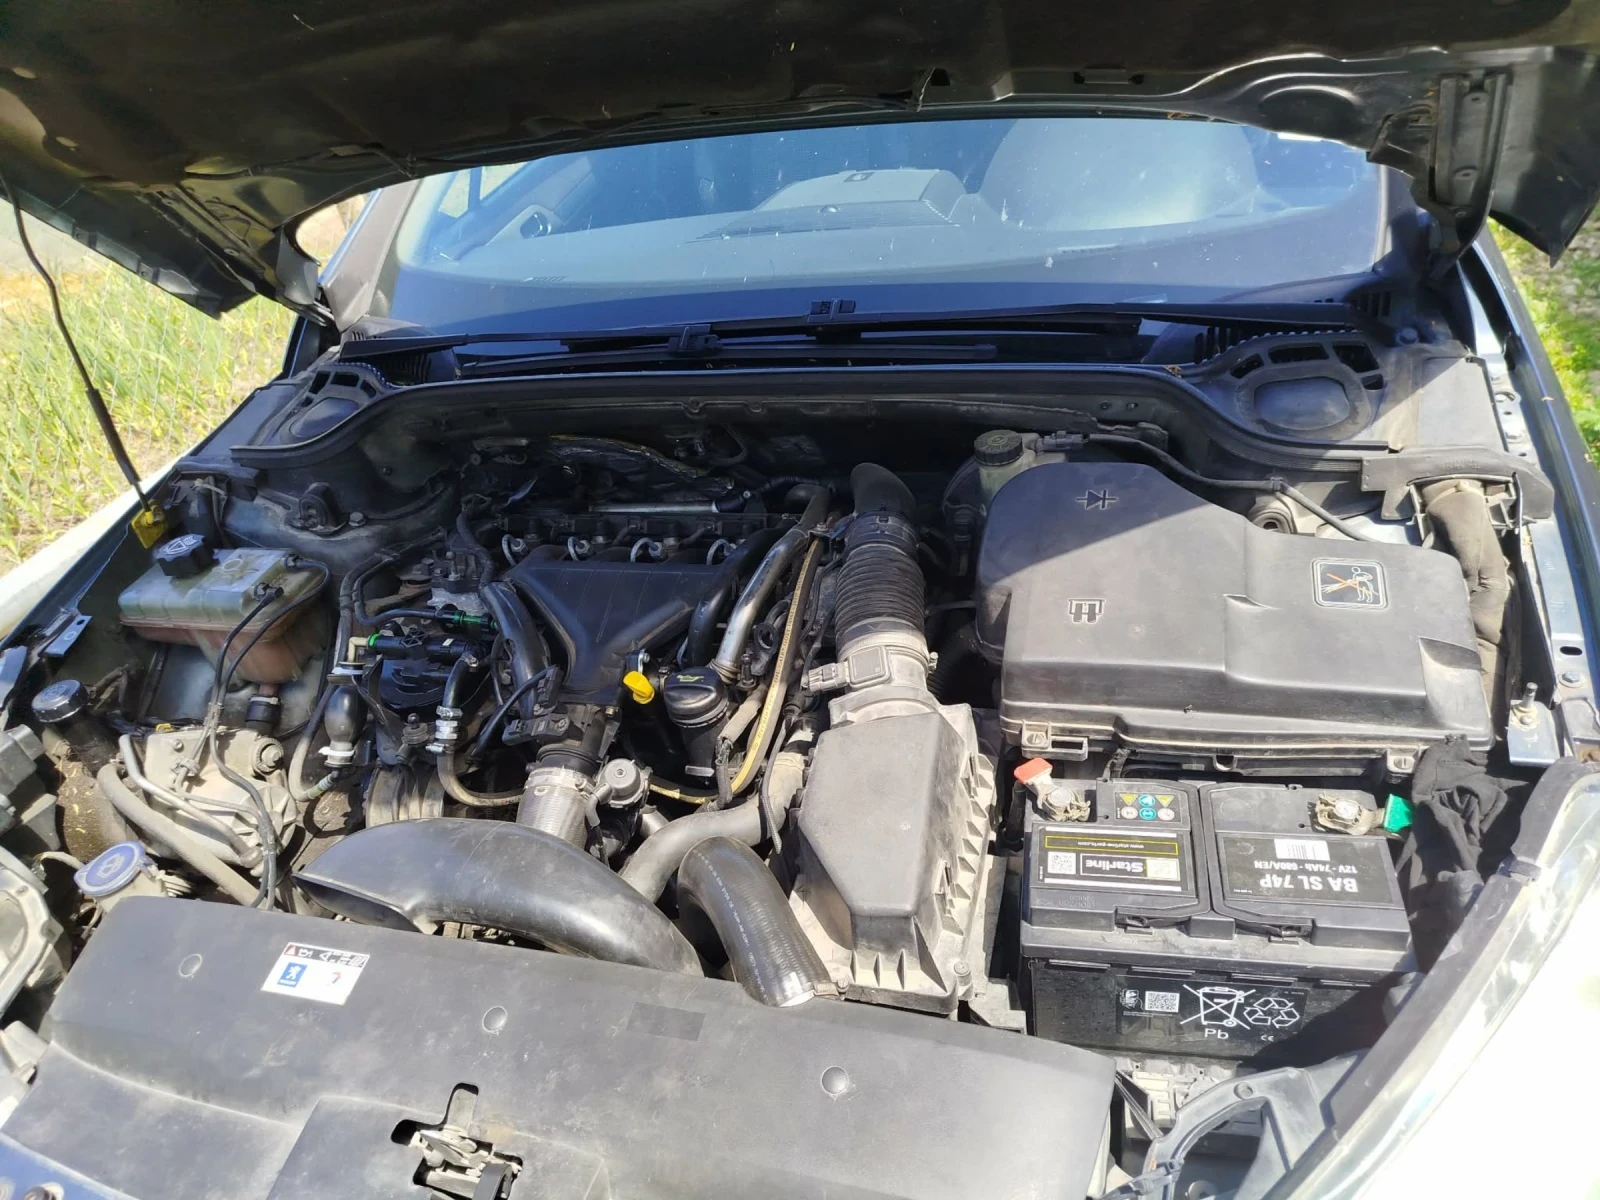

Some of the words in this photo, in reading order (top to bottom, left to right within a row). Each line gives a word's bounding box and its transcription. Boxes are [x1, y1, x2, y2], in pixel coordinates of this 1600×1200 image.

[1078, 841, 1144, 849] www.starline-parts.com
[1085, 859, 1144, 873] Starline
[1304, 863, 1332, 873] 74Ah
[1338, 864, 1358, 874] 12V
[1260, 873, 1294, 889] 74P
[1297, 875, 1323, 890] SL
[1327, 877, 1359, 892] BA
[1204, 1028, 1229, 1039] Pb
